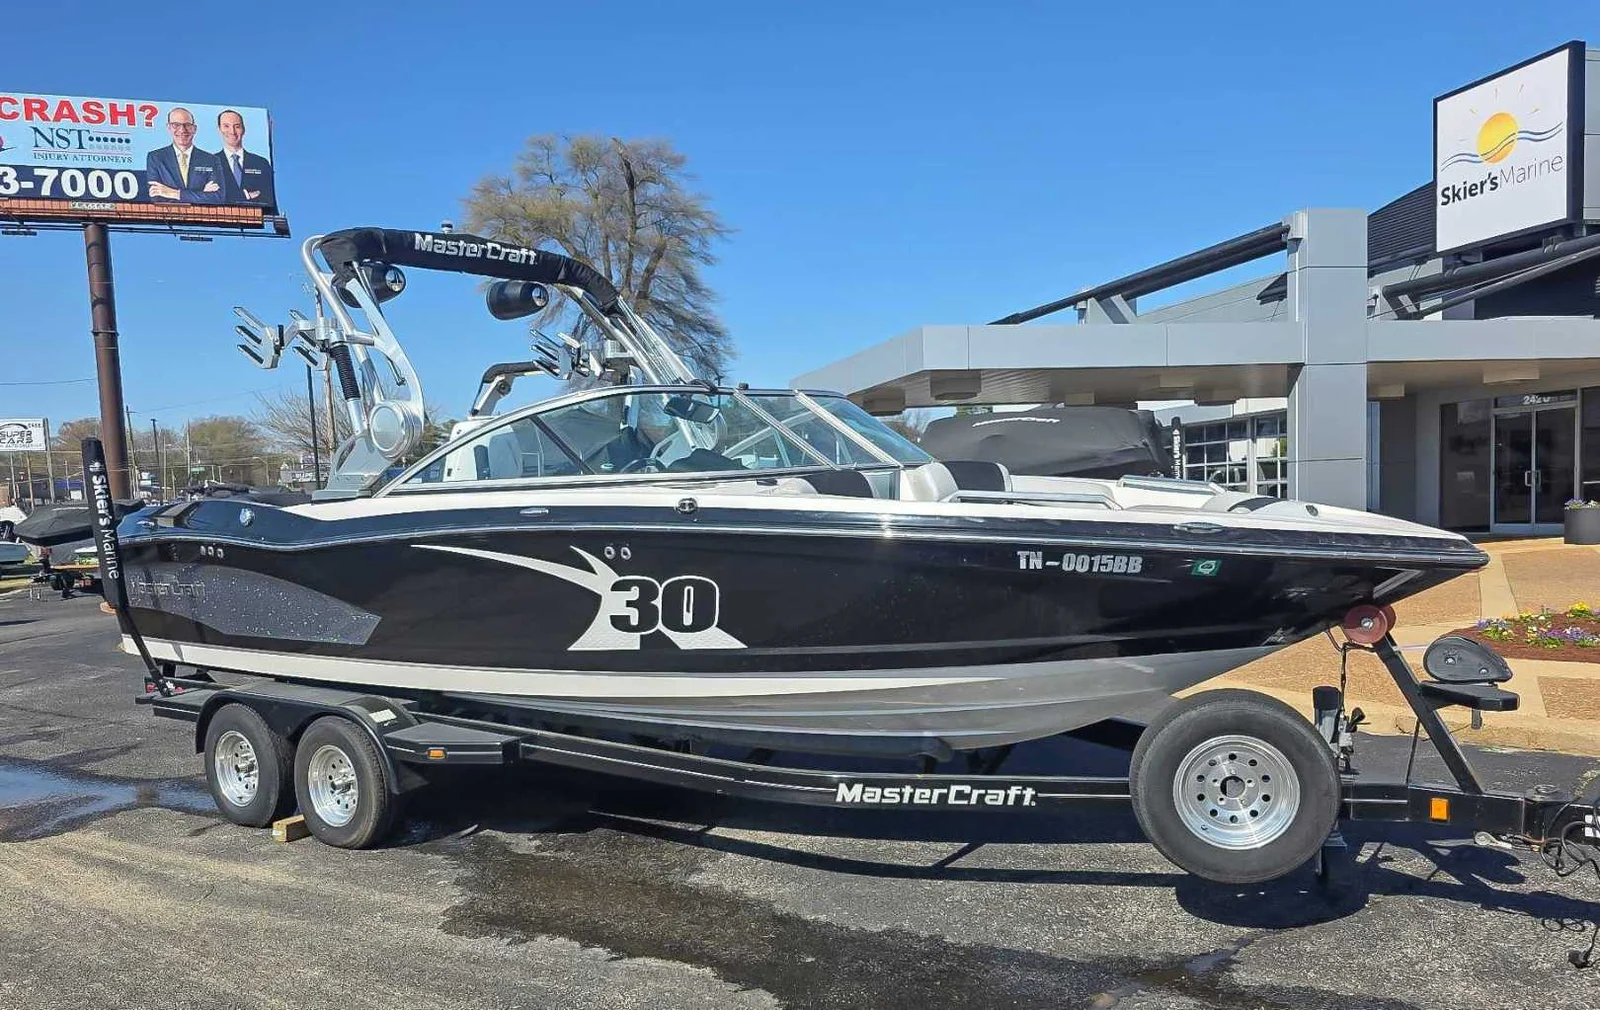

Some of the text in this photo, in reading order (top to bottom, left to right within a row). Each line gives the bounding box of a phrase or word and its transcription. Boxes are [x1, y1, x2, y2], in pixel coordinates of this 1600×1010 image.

[0, 96, 159, 127] CRASH?
[30, 125, 91, 150] NST
[33, 152, 133, 164] INJURY ATTORNEYS
[0, 166, 139, 199] 3-7000
[414, 232, 538, 265] MasterCraft
[0, 430, 33, 438] SUPER
[92, 474, 120, 580] Skier's Marine
